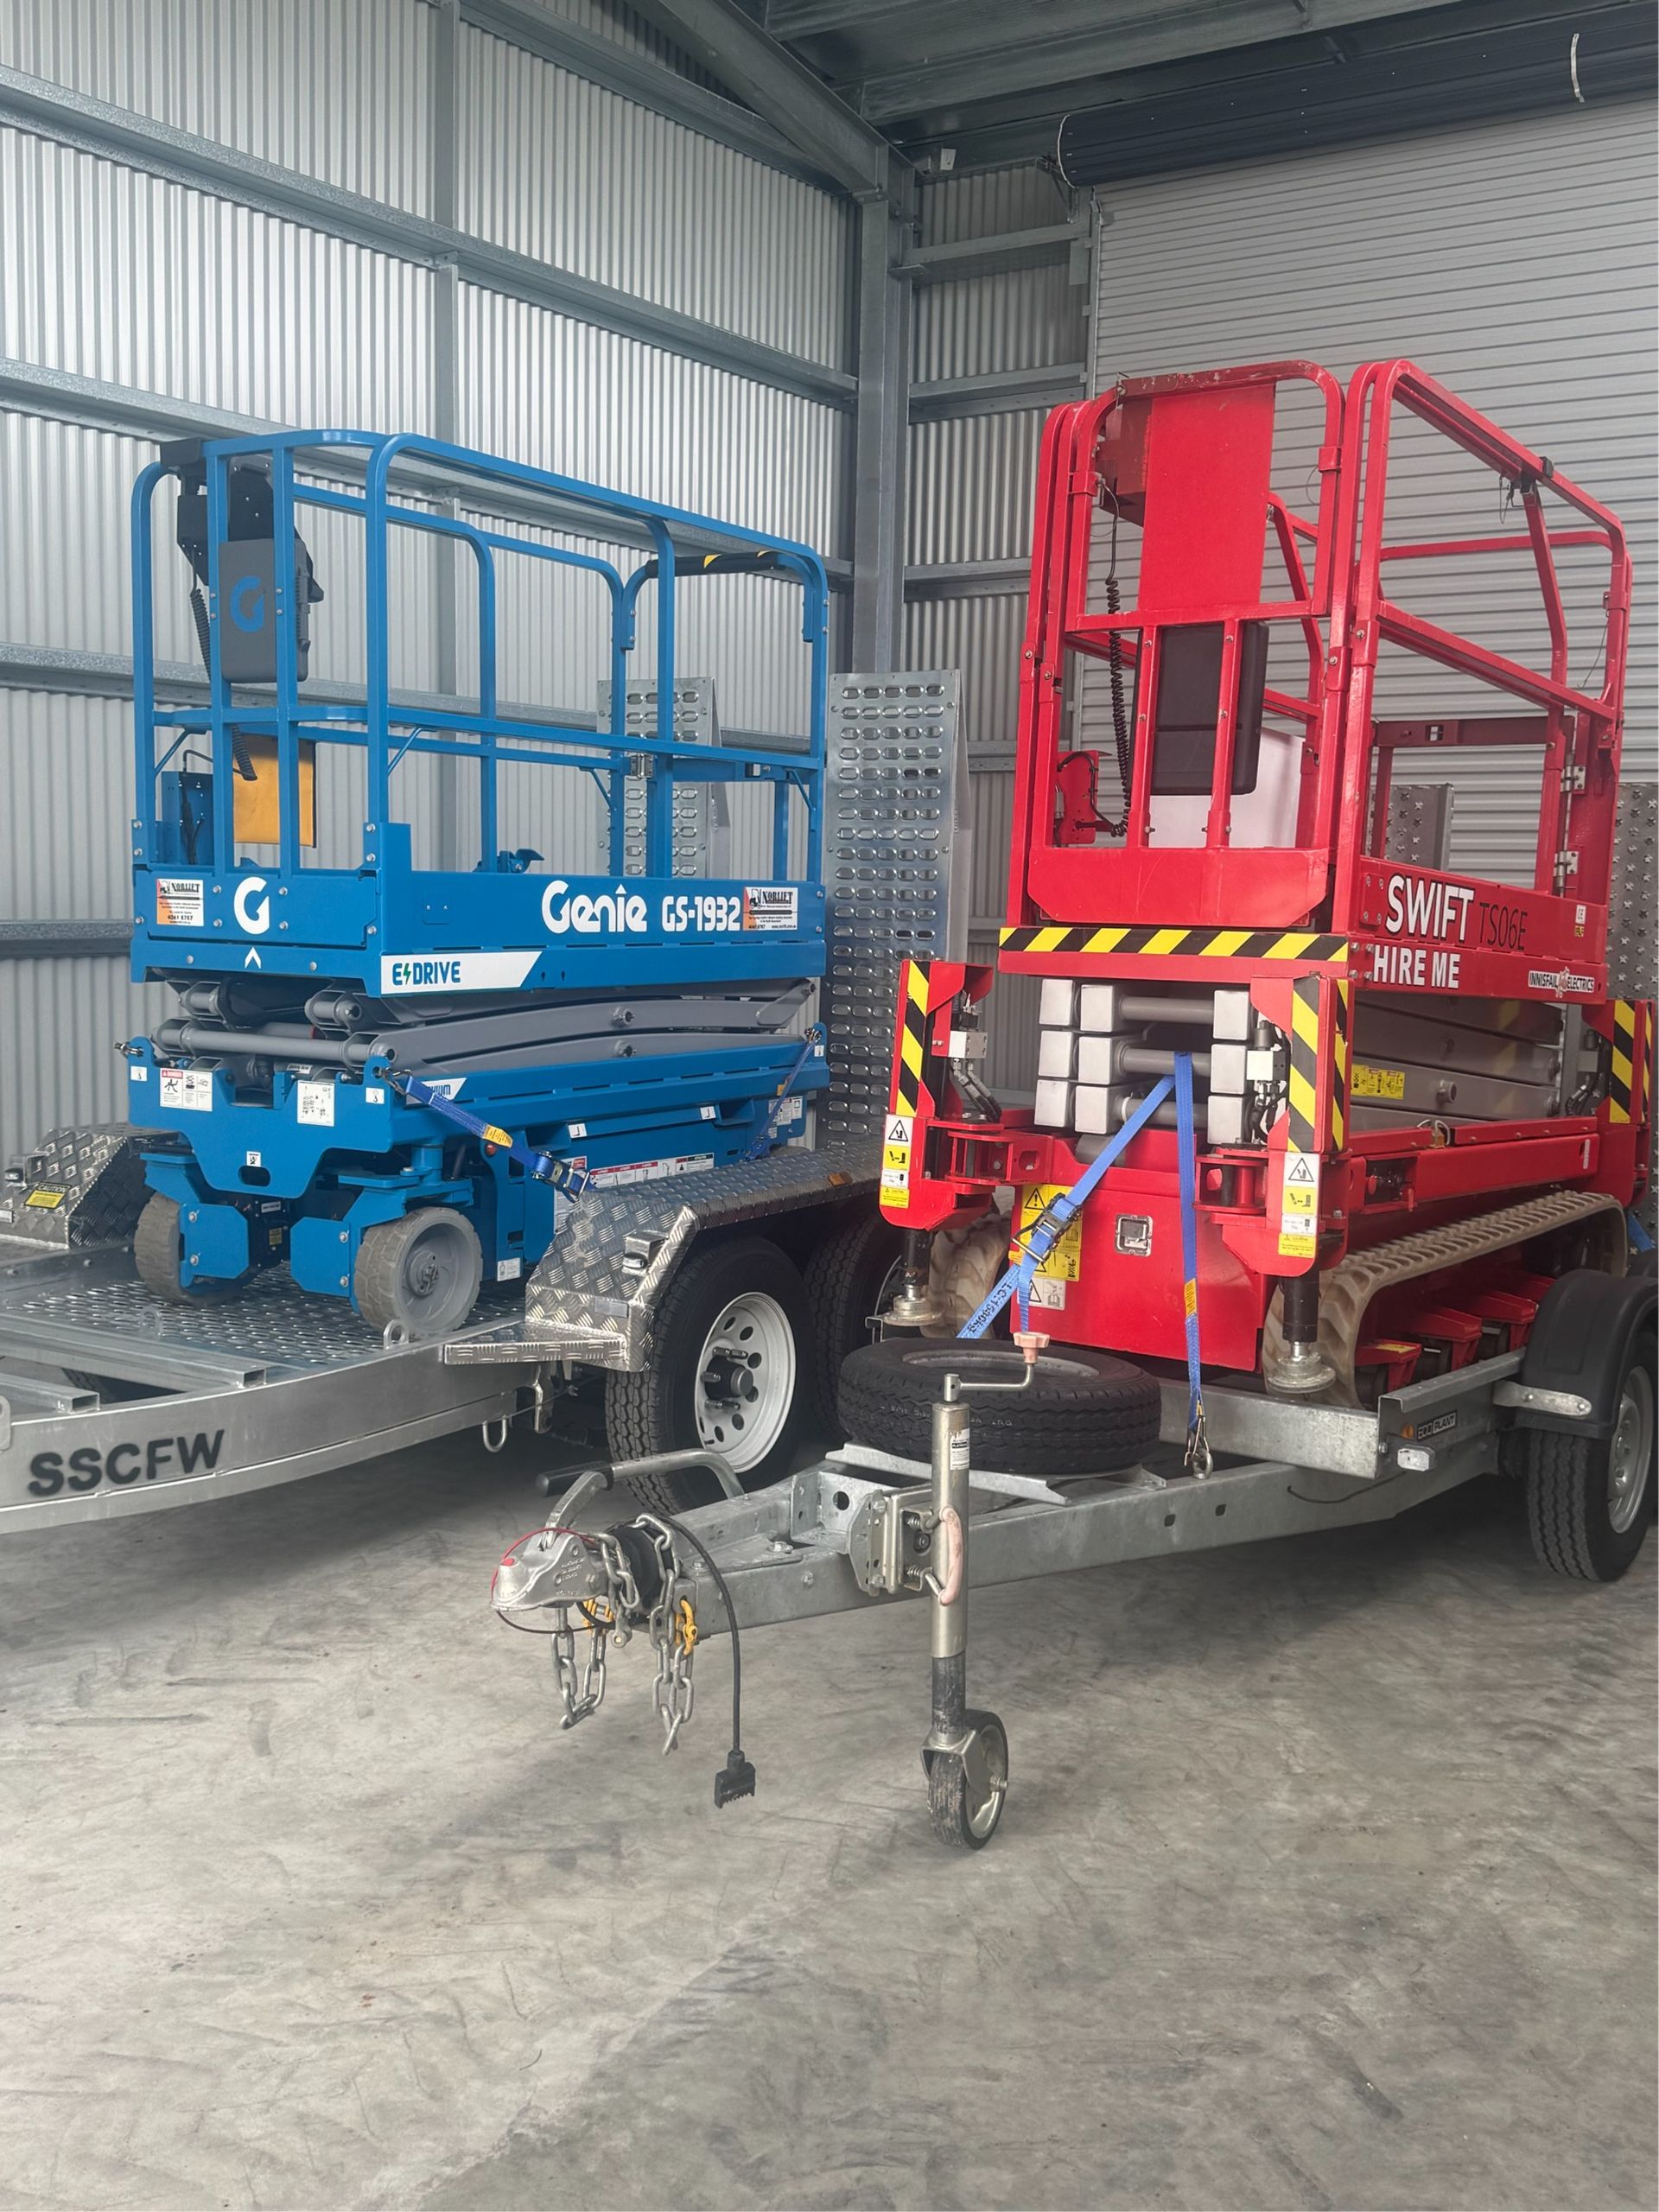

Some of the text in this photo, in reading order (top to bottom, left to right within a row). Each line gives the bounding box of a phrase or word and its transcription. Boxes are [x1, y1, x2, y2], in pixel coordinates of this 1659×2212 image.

[542, 880, 741, 934] Genie GS-1932
[1384, 874, 1528, 950] SWIFT TS06E
[1373, 944, 1461, 988] HIRE ME
[1529, 972, 1594, 992] INNISFAIL ELECTRICS
[28, 1429, 225, 1497] SSCFW
